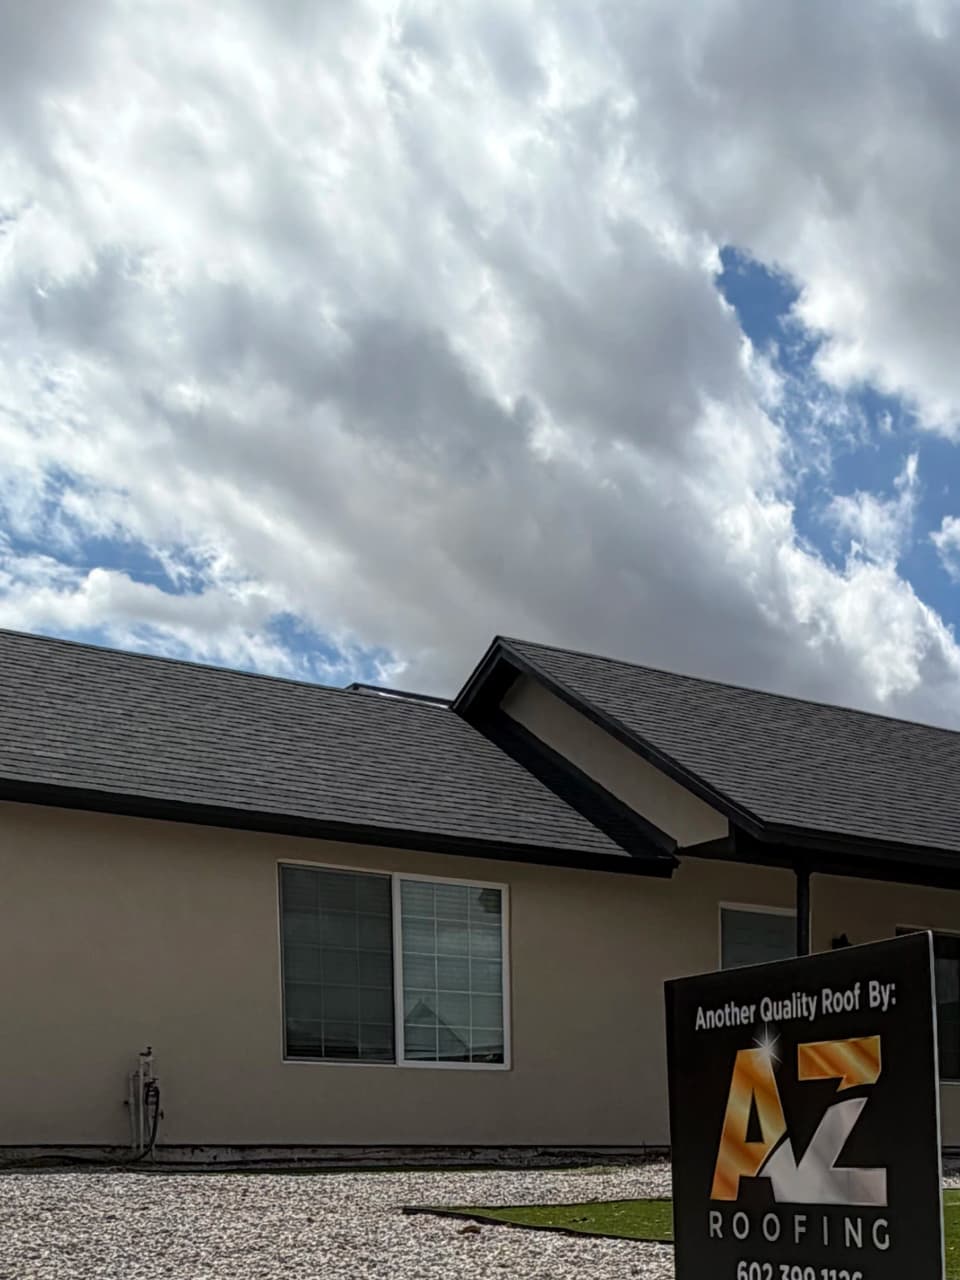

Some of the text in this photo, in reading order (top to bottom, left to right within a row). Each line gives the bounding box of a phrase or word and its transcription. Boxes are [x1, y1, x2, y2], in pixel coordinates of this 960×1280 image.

[695, 980, 897, 1031] Another Quality Roof By:
[710, 1034, 888, 1207] AZ
[709, 1210, 890, 1250] ROOFING
